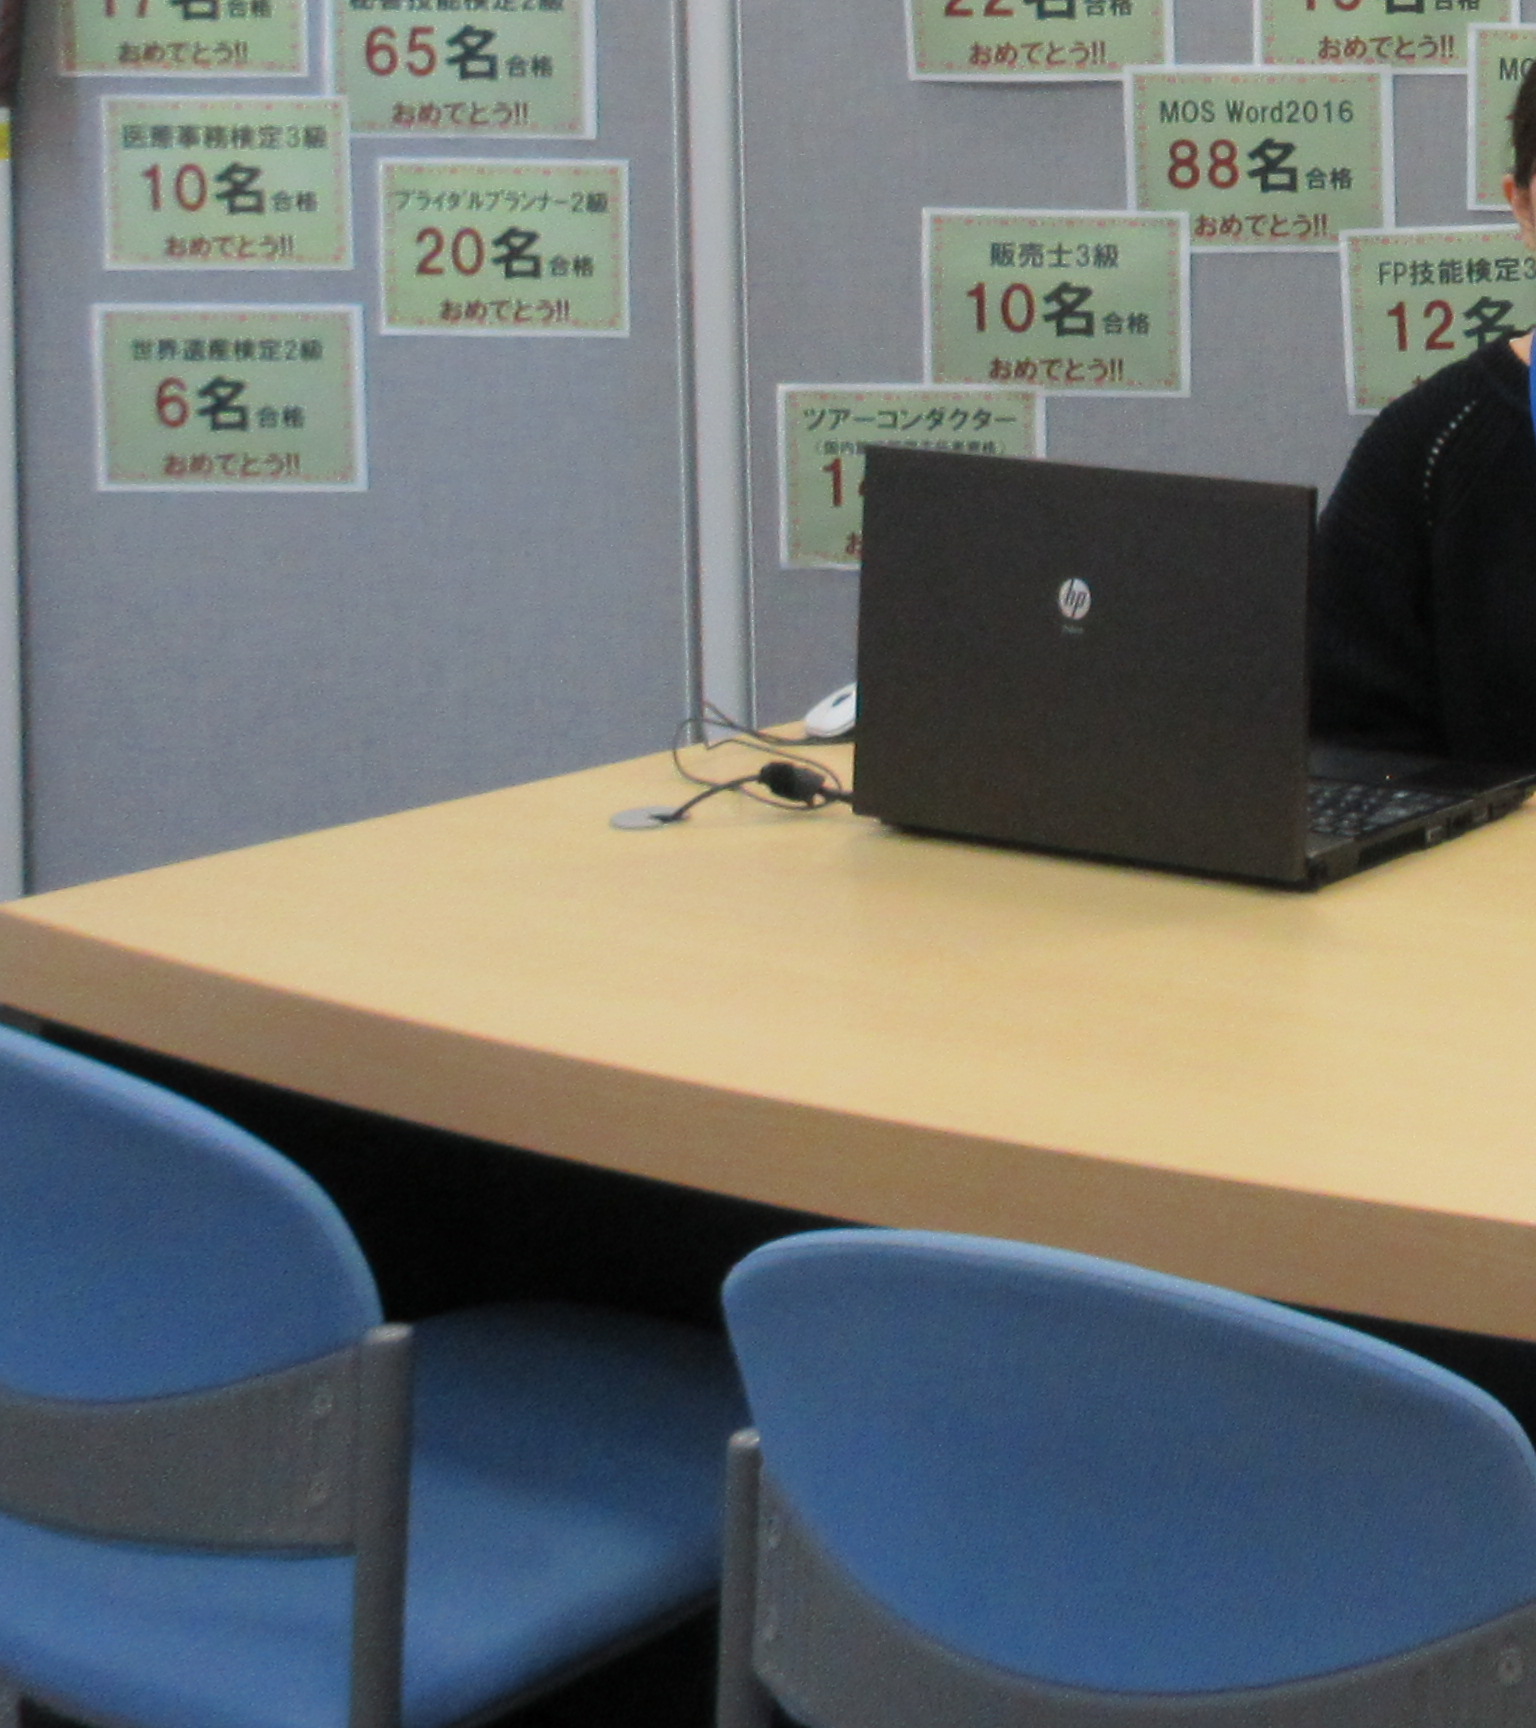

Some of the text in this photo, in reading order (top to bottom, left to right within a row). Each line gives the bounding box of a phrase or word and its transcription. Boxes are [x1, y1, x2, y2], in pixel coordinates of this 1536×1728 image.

[1160, 99, 1354, 123] MOS Word2016
[990, 243, 1120, 269] 販売士3級
[803, 407, 1017, 432] ツアーコンダクター
